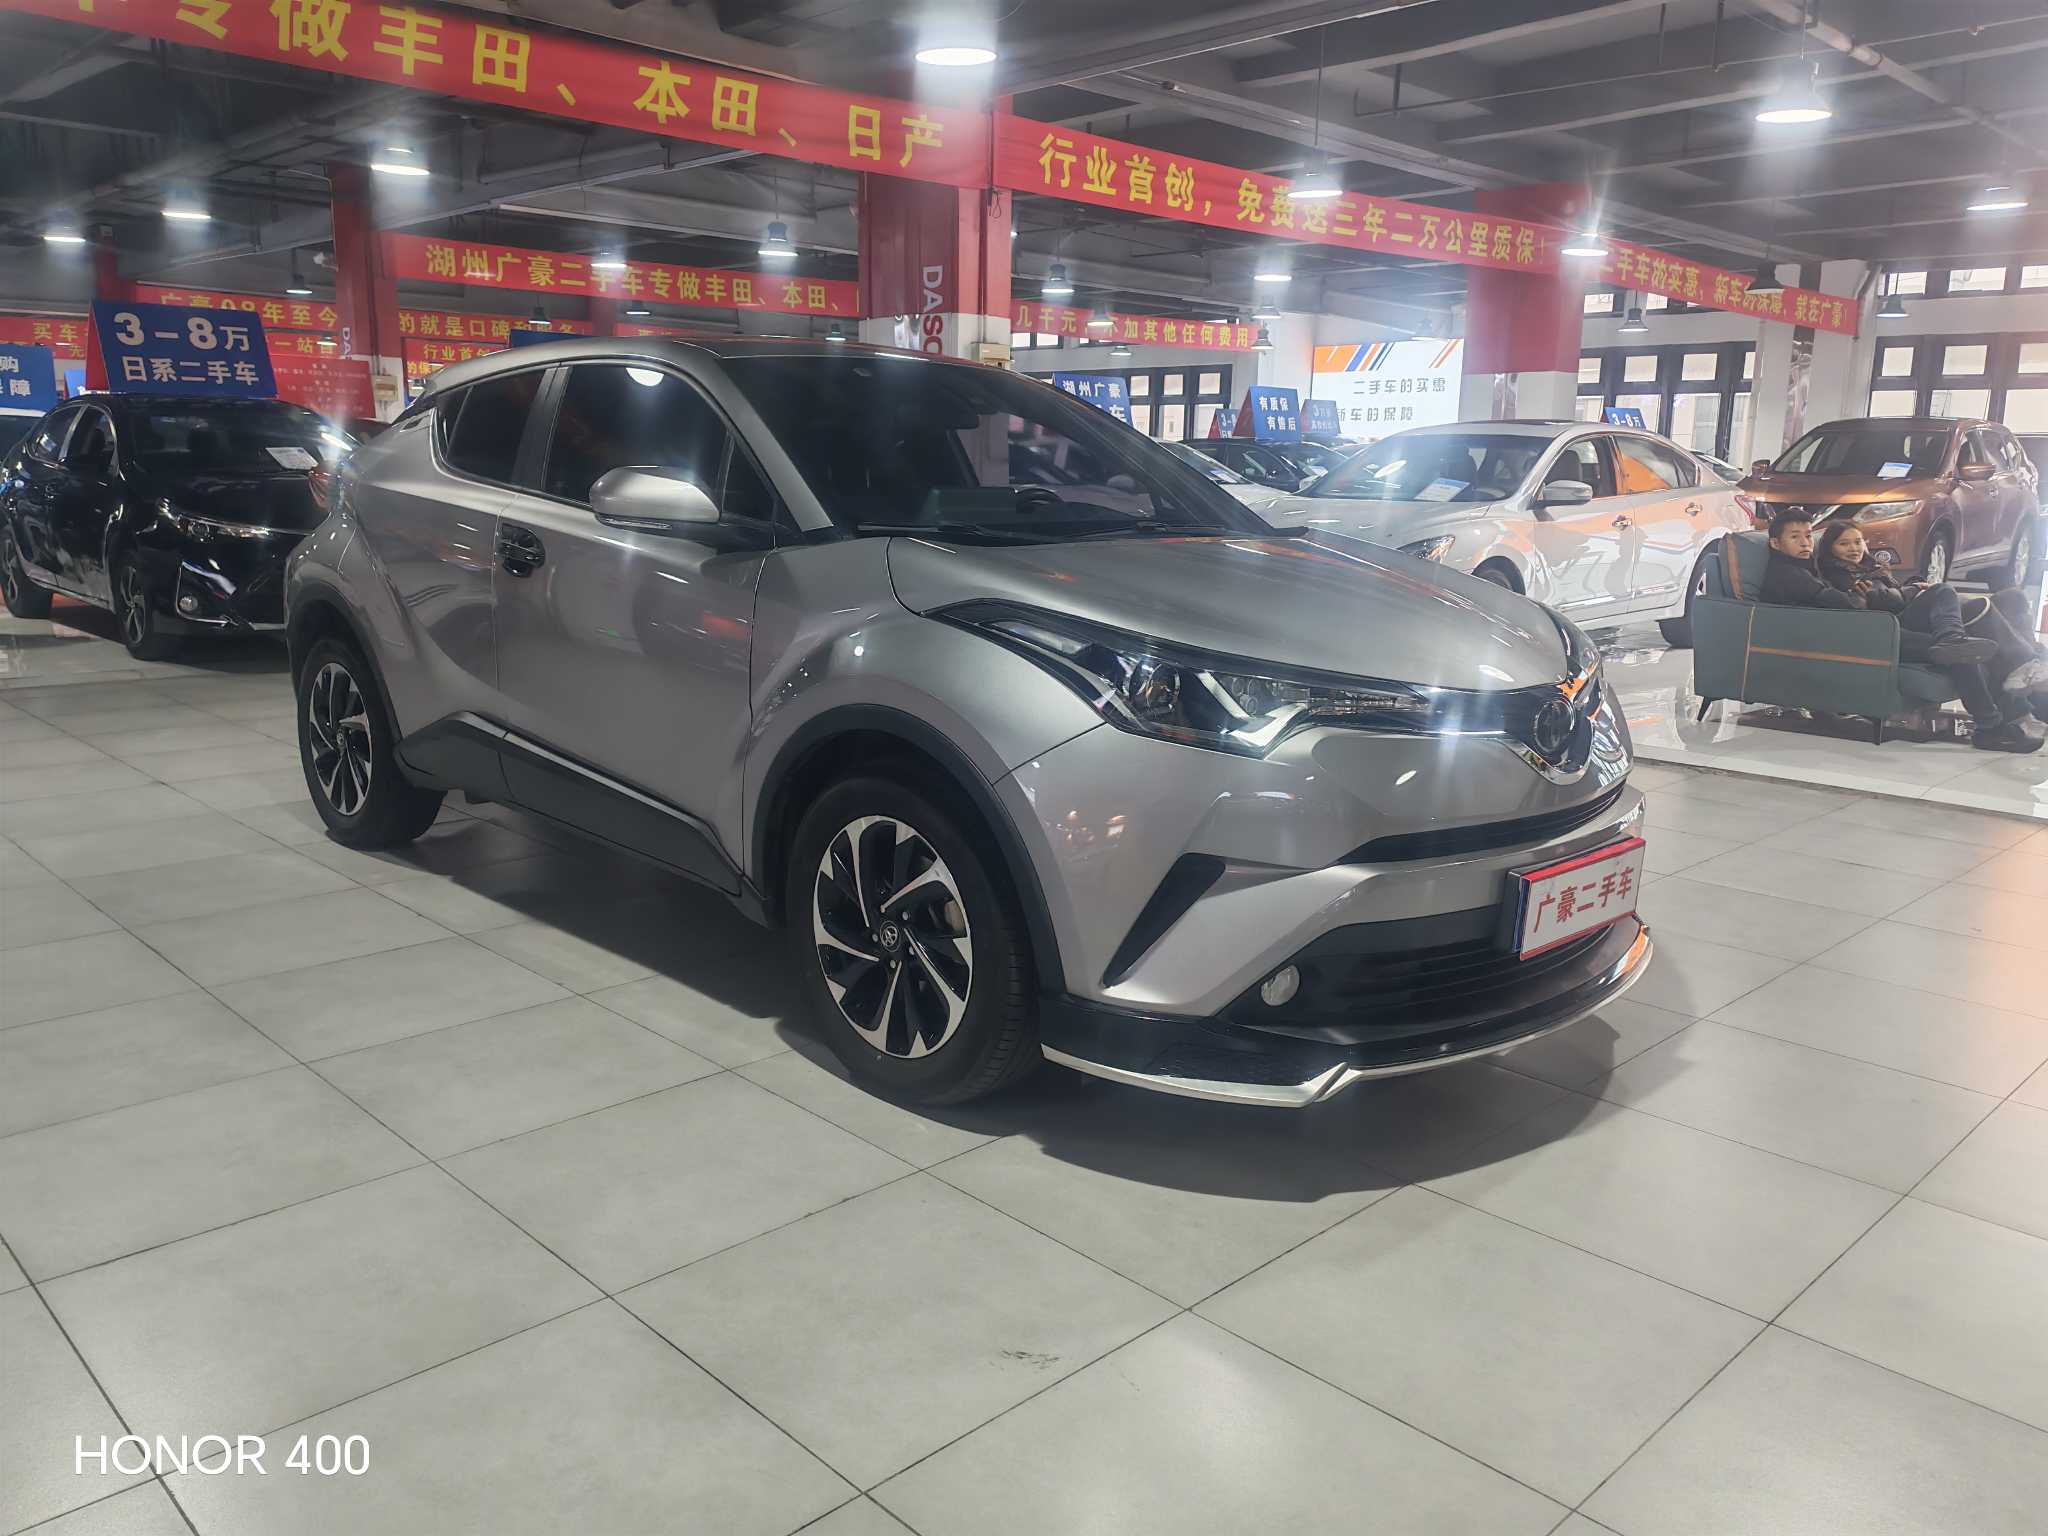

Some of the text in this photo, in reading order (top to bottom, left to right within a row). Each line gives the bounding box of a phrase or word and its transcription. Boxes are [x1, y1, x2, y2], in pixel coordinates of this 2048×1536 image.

[79, 0, 944, 168] 专做丰田、本田、日产
[426, 244, 860, 312] 湖州广豪二手车专做丰田、本田、
[33, 322, 88, 342] 买车
[121, 356, 260, 386] 日系二手车
[1353, 377, 1446, 395] 二手车的实惠
[0, 379, 31, 396] 障
[1534, 866, 1634, 933] 广豪二手车
